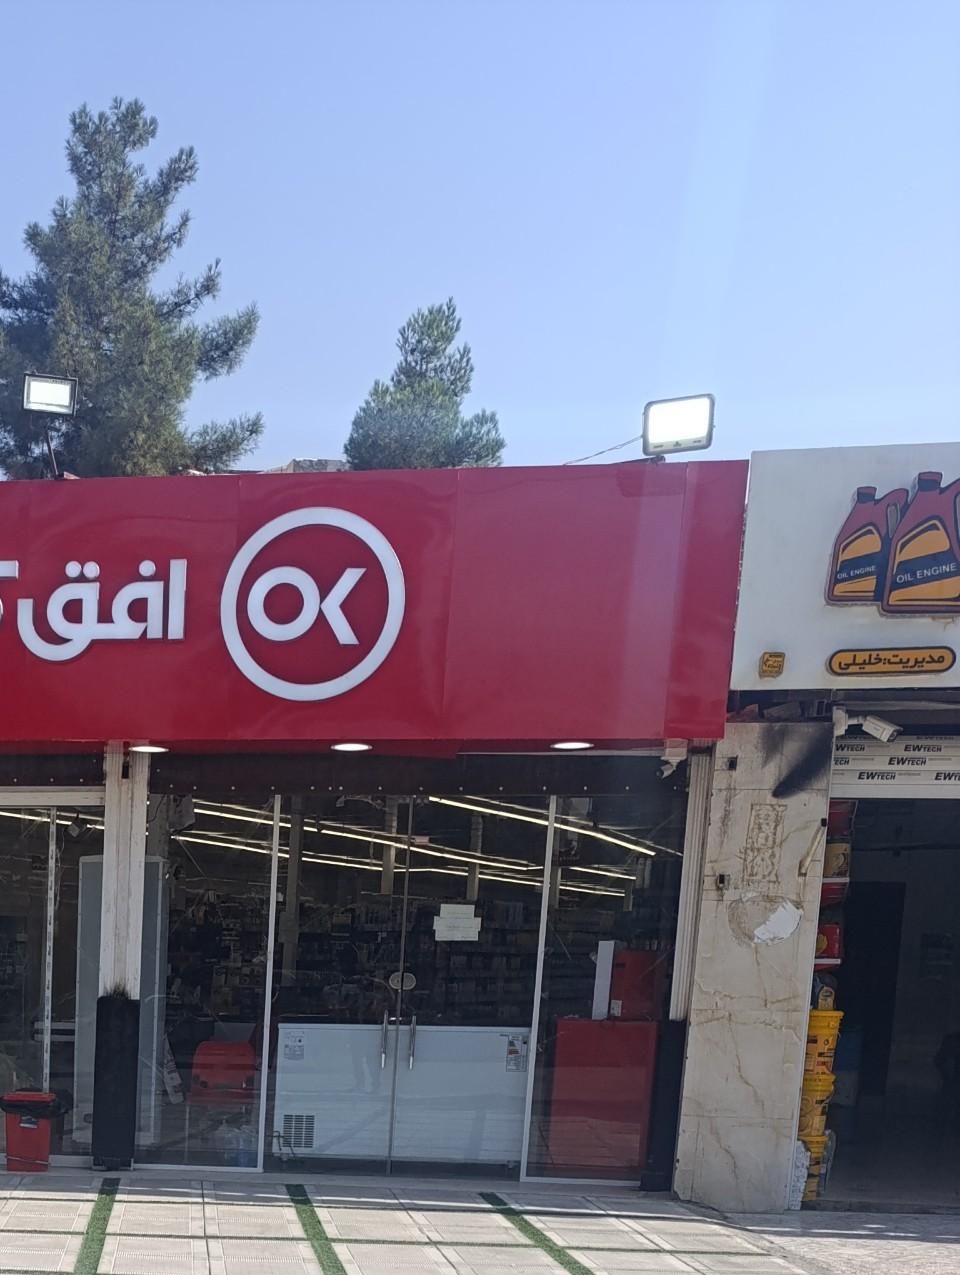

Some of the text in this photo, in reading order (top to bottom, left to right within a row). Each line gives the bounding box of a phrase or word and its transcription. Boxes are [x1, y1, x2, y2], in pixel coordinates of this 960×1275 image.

[837, 564, 877, 580] OIL ENGINE
[896, 562, 958, 584] OIL ENGINE
[17, 558, 188, 663] افق
[246, 565, 367, 646] OK
[835, 744, 866, 752] WTECH
